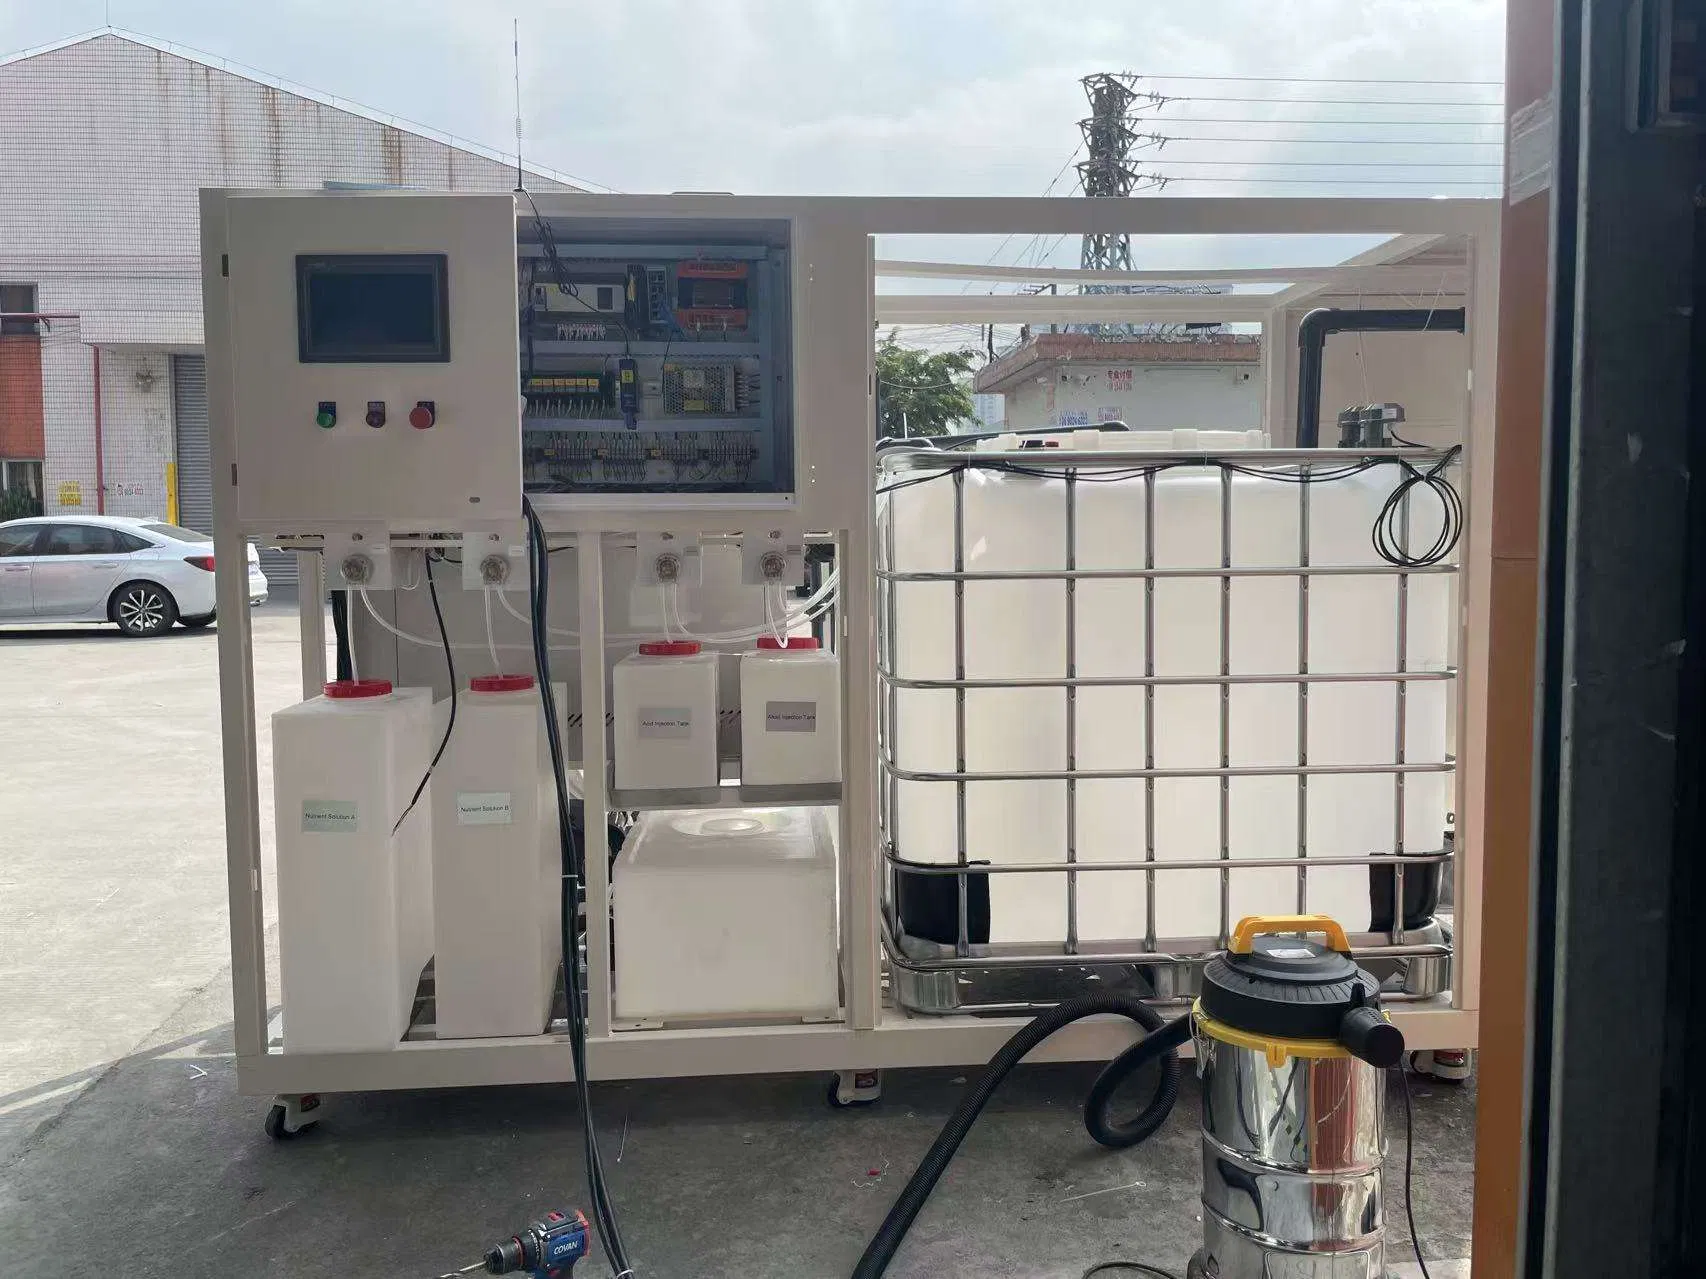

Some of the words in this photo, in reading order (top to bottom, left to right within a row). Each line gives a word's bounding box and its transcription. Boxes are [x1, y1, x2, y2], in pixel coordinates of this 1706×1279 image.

[781, 713, 802, 721] Injection
[655, 720, 676, 728] Injection
[305, 812, 327, 820] Nutrient
[553, 1240, 579, 1255] COVAN
